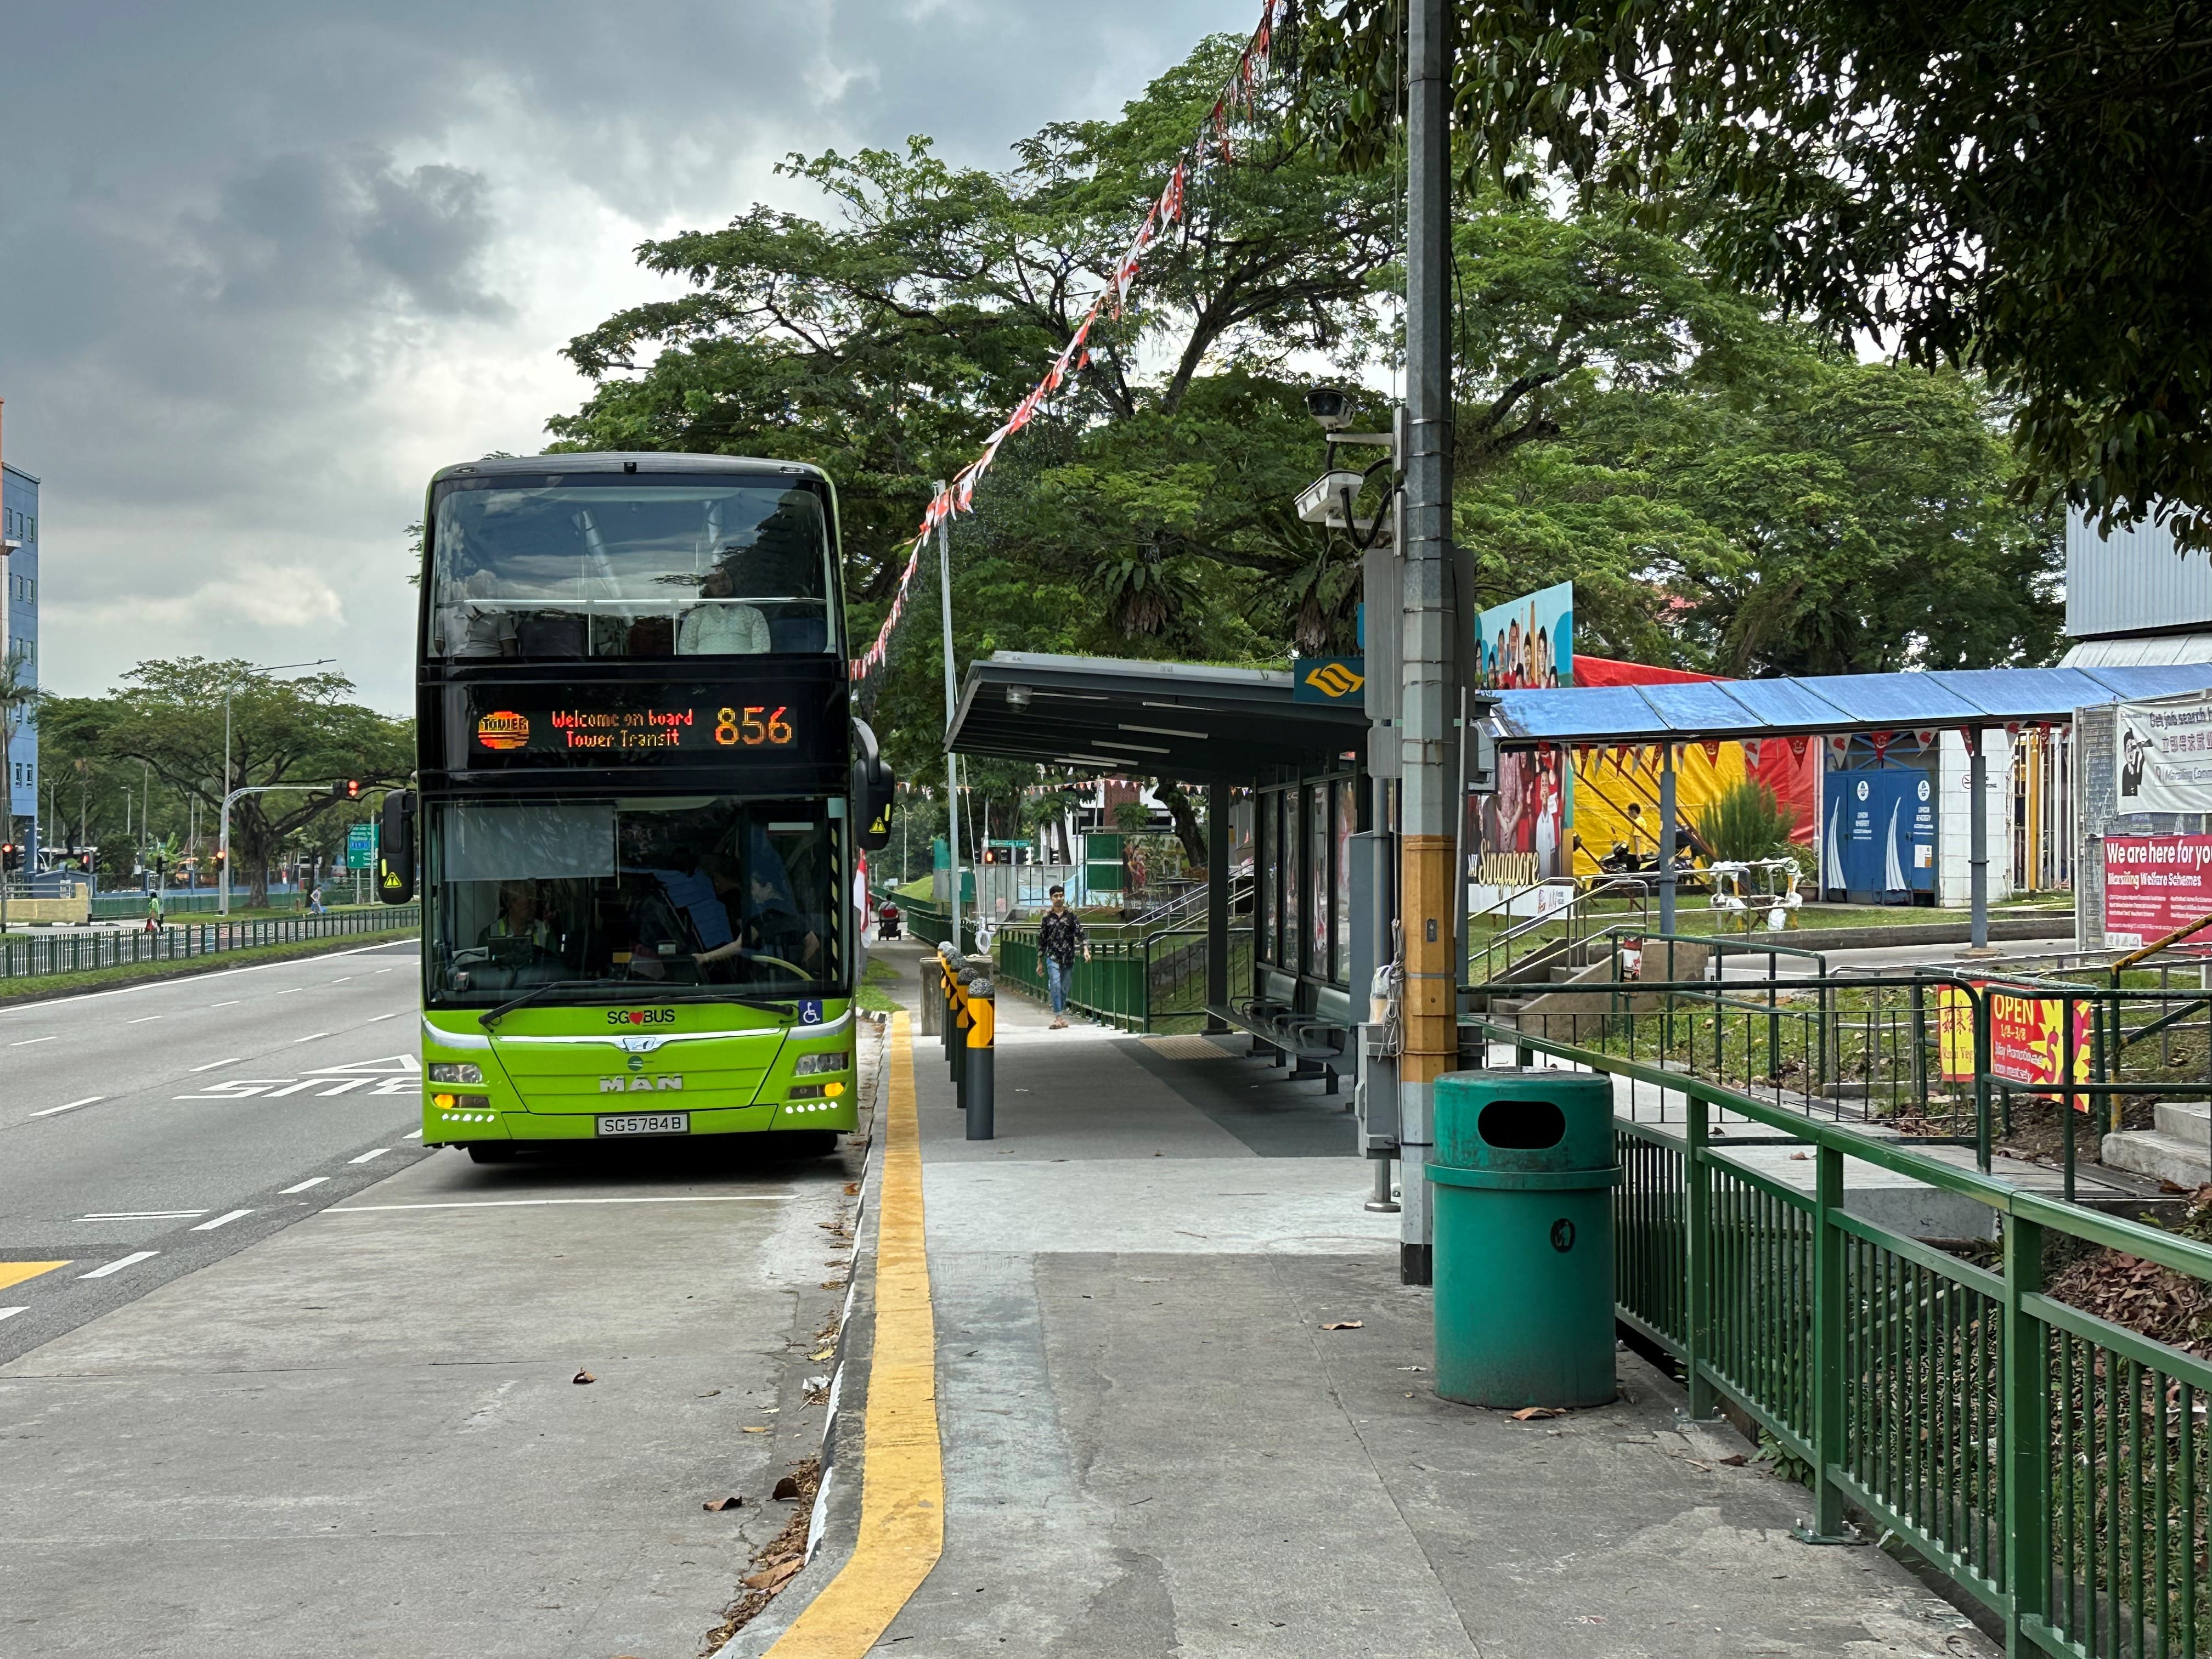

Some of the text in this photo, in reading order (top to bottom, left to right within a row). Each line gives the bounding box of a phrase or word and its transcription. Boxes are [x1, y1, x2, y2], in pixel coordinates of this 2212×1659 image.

[552, 708, 693, 727] Welcome on board
[715, 707, 792, 745] 856
[566, 729, 680, 748] Tower Transit
[2107, 839, 2212, 871] We are here for yo
[1479, 838, 1540, 901] Singapore
[1994, 995, 2034, 1026] OPEN
[599, 1073, 683, 1093] MAN
[605, 1117, 681, 1132] SG5784B
